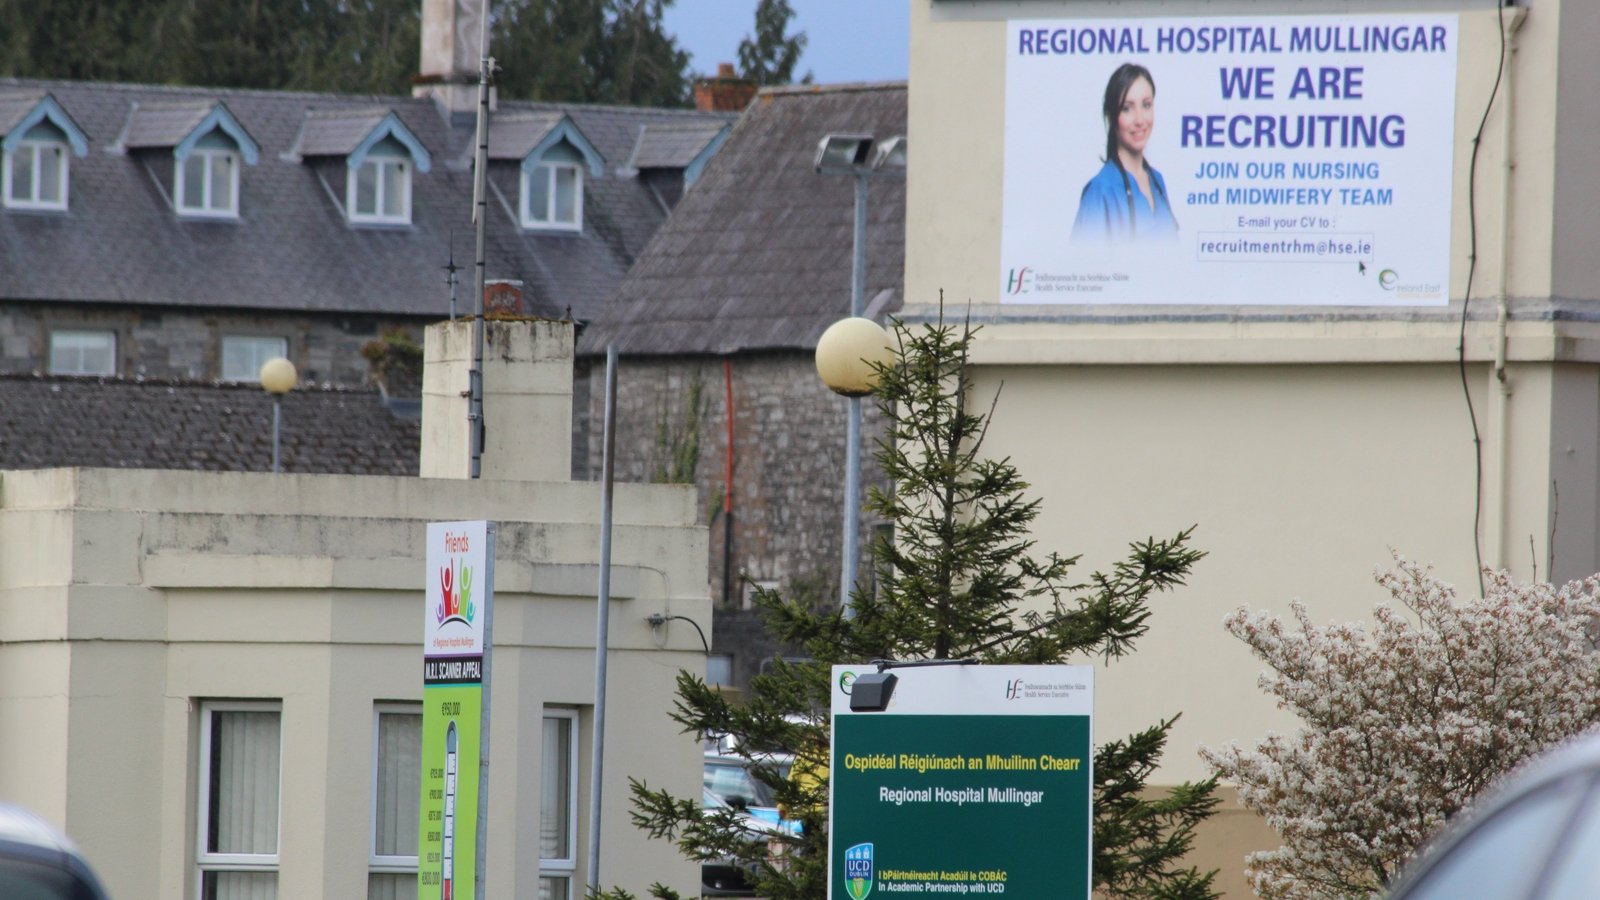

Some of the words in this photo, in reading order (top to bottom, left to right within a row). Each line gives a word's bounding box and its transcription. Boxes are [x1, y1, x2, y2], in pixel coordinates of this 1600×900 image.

[1018, 26, 1149, 55] REGIONAL
[1156, 26, 1282, 54] HOSPITAL
[1289, 25, 1447, 53] MULLINGAR
[1219, 67, 1275, 100] WE
[1289, 67, 1364, 100] ARE
[1180, 114, 1406, 149] RECRUITING
[1195, 162, 1239, 179] JOIN
[1246, 162, 1286, 179] OUR
[1292, 162, 1380, 180] NURSING
[1187, 188, 1219, 205] and
[1226, 188, 1333, 205] MIDWIFERY
[1339, 188, 1393, 206] TEAM
[1238, 216, 1270, 228] E-mail
[1273, 218, 1297, 230] your
[1300, 216, 1316, 228] CV
[1200, 239, 1371, 255] recruitmentrhm@hse.ie
[445, 531, 469, 553] Friends
[439, 662, 462, 679] SCANNER
[462, 661, 481, 679] APPEAL
[844, 753, 896, 773] Ospidéal
[899, 753, 965, 773] Réigiúnach
[968, 757, 983, 770] an
[986, 754, 1037, 770] Mhuilinn
[1040, 754, 1080, 771] Chearr
[879, 786, 932, 805] Regional
[935, 787, 984, 806] Hospital
[987, 787, 1044, 807] Mullingar
[848, 860, 870, 871] UCD
[970, 870, 977, 880] le
[978, 869, 1007, 881] COBÁC
[878, 882, 886, 891] In
[887, 882, 924, 892] Academic
[925, 882, 968, 895] Partnership
[969, 883, 986, 893] with
[987, 883, 1005, 893] UCD
